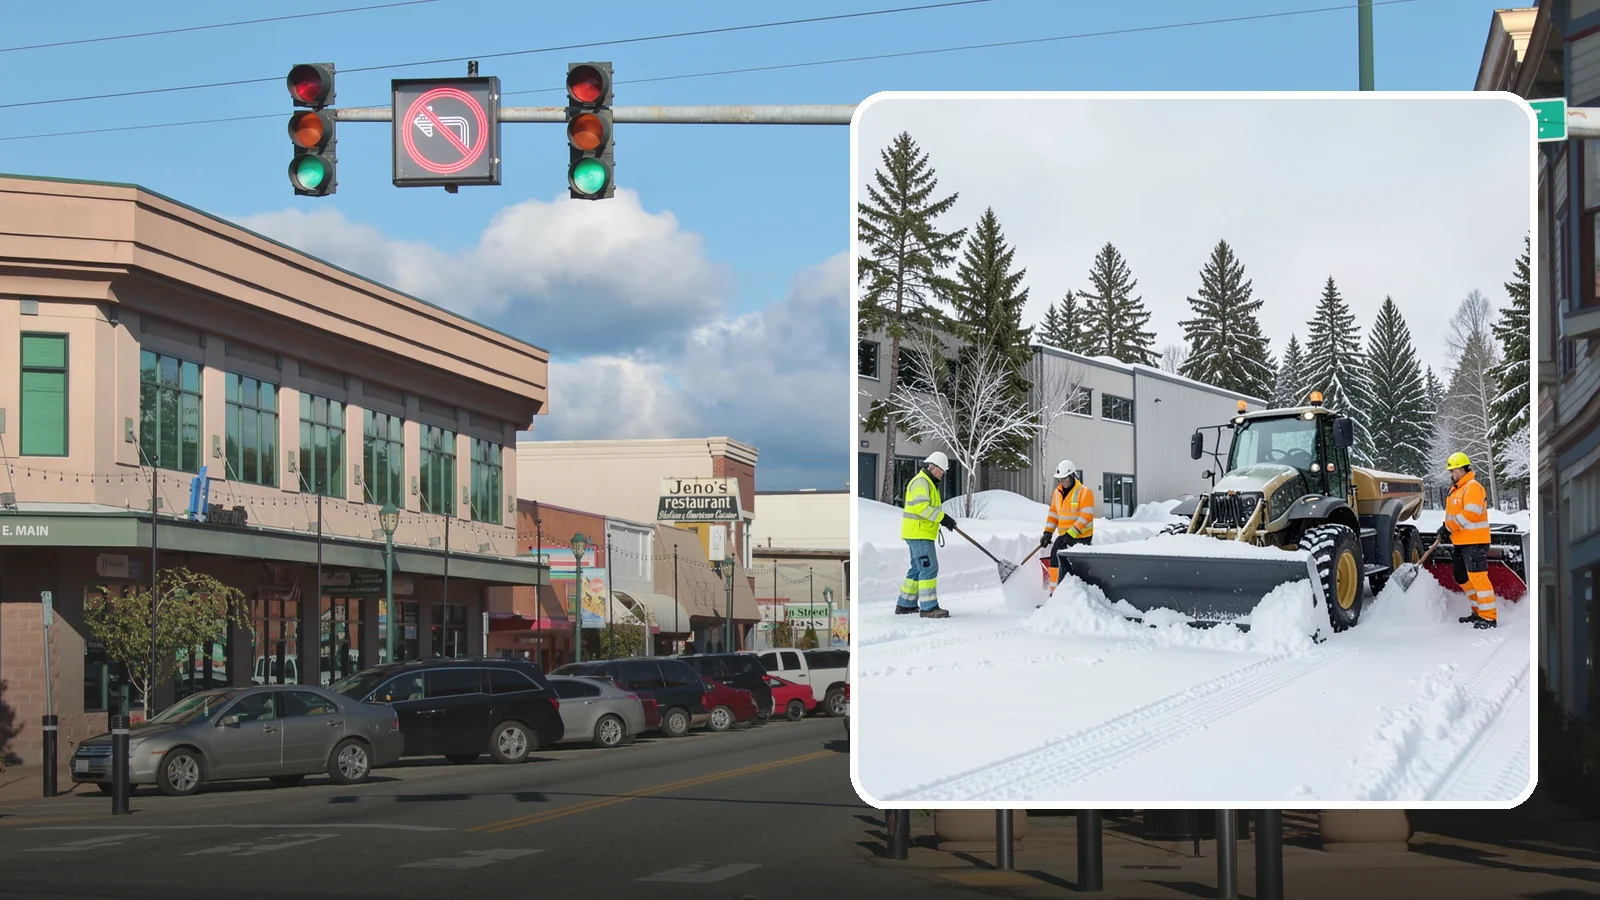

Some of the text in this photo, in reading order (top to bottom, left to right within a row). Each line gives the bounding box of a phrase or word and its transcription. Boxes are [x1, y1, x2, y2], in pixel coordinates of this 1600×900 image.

[670, 480, 727, 494] Jeno's
[665, 496, 731, 509] restaurant
[658, 510, 681, 520] Italian
[686, 509, 714, 519] American
[715, 510, 737, 519] Cuisine
[2, 525, 49, 536] E. MAIN
[797, 607, 829, 617] Street
